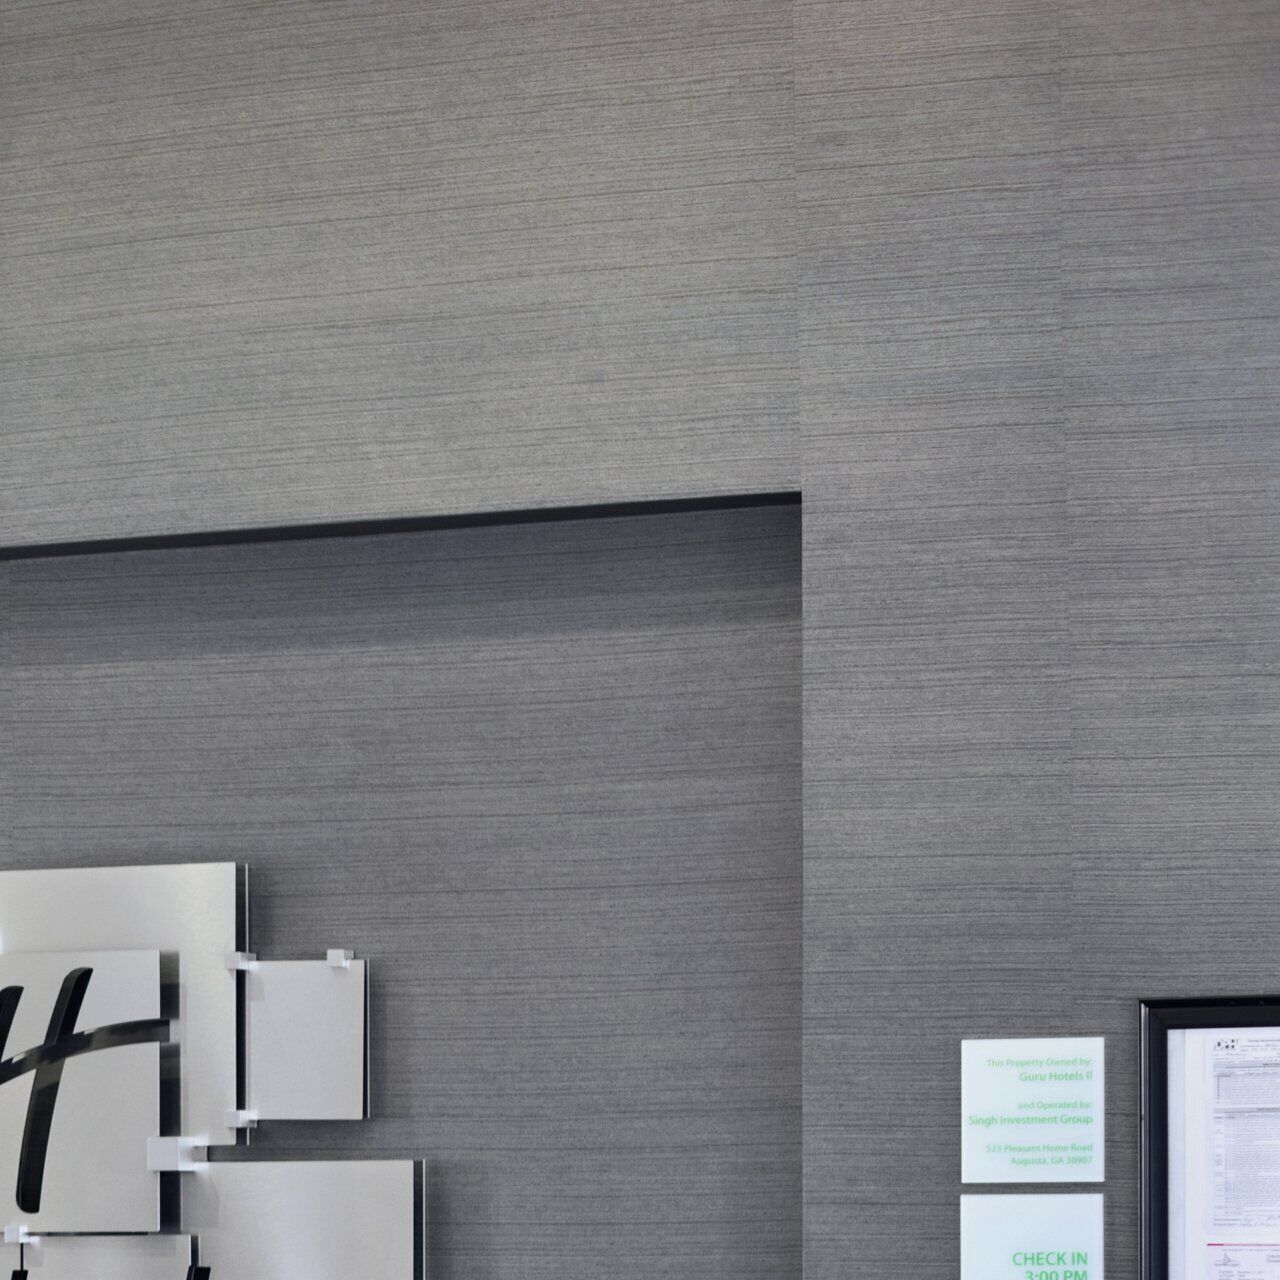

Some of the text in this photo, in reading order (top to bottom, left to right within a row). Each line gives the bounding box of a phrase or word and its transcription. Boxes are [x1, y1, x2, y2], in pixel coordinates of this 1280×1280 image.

[987, 1059, 1004, 1067] This
[1006, 1058, 1044, 1068] Property
[1046, 1058, 1078, 1066] Owned
[1019, 1072, 1046, 1082] Guru
[1048, 1071, 1084, 1081] Hotels
[1017, 1101, 1035, 1110] and
[1036, 1100, 1078, 1110] Operated
[968, 1114, 1093, 1127] Singh Investment Group
[1003, 1143, 1040, 1152] Pleasant
[1042, 1143, 1068, 1152] Home
[1070, 1143, 1093, 1152] Road
[1050, 1156, 1064, 1165] GA
[1012, 1251, 1088, 1266] CHECK IN
